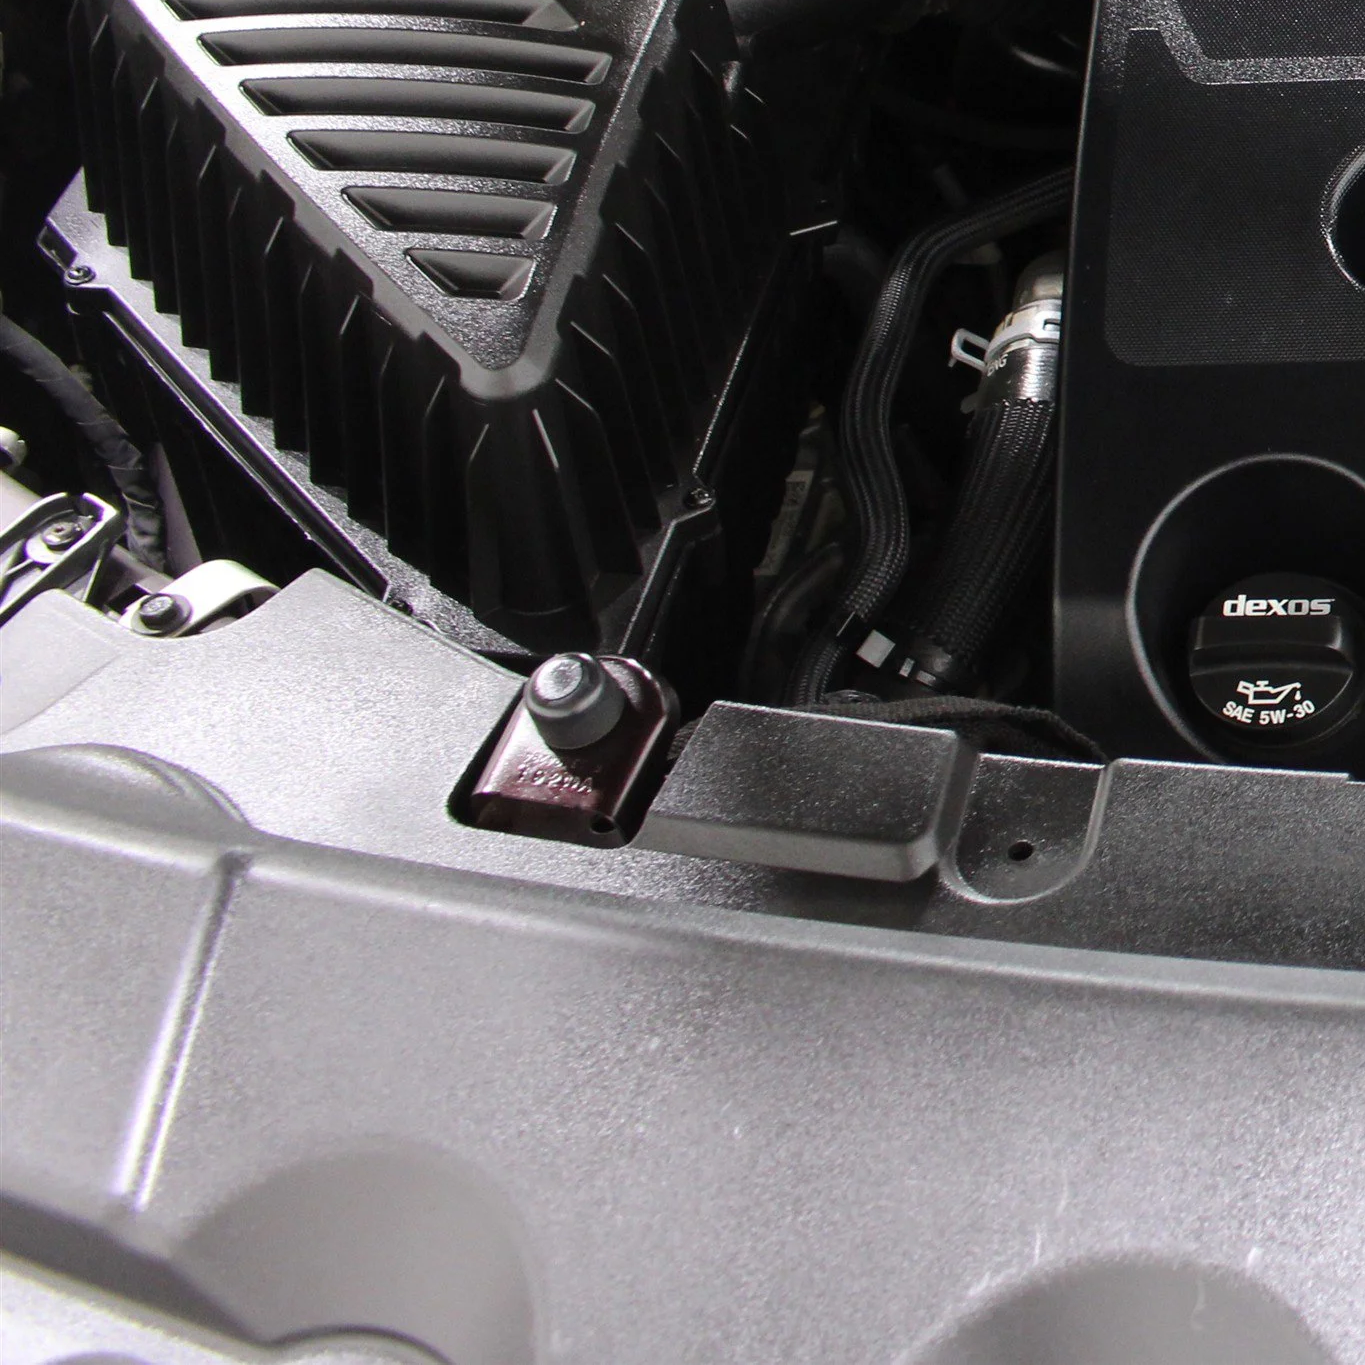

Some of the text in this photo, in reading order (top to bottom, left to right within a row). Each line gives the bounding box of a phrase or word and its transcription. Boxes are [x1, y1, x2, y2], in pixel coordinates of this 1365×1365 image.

[1221, 593, 1333, 617] dexos
[1221, 698, 1317, 726] SAE 5W-30
